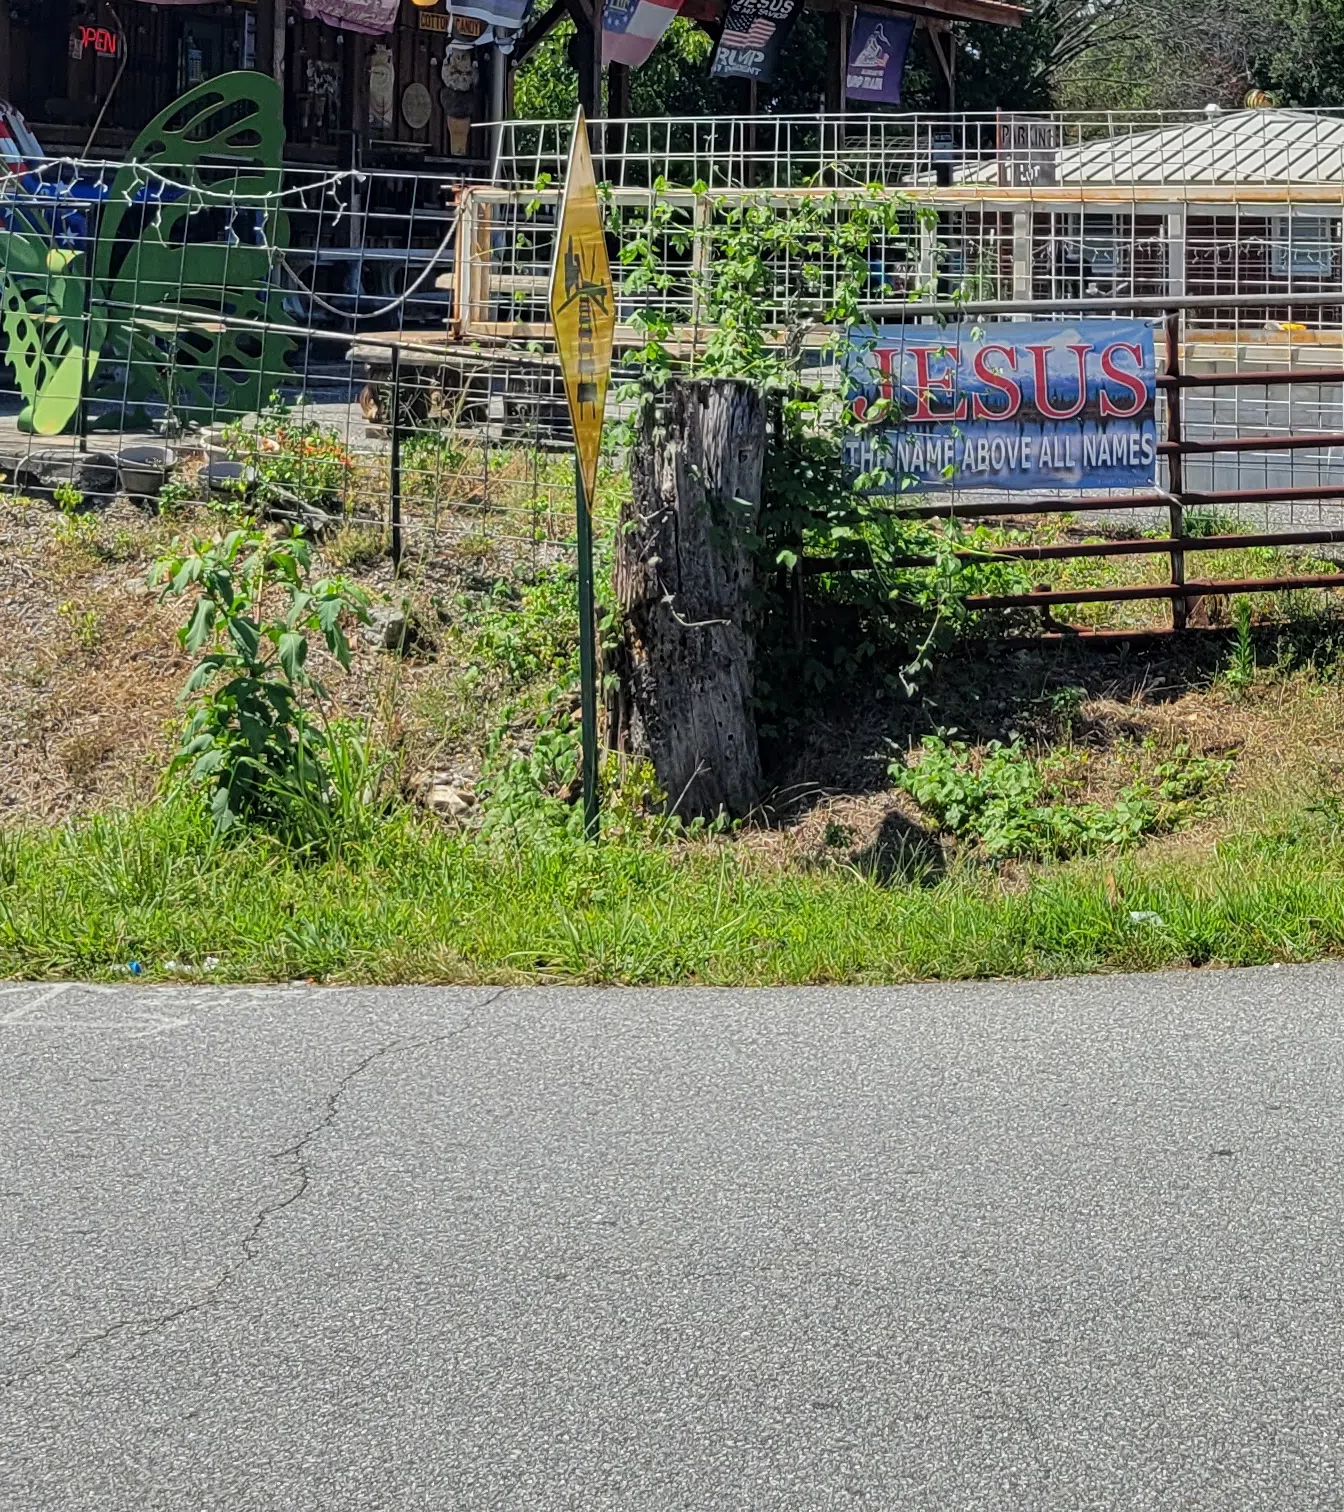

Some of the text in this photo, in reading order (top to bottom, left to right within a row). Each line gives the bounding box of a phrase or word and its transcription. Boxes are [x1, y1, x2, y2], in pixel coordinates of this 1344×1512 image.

[420, 12, 448, 30] COTTO
[741, 7, 757, 15] MY
[757, 9, 789, 20] SAVIOR
[852, 342, 1148, 425] JESUS
[896, 438, 955, 472] NAME
[962, 436, 1032, 471] ABOVE
[1038, 435, 1076, 469] ALL
[1082, 432, 1154, 468] NAMES
